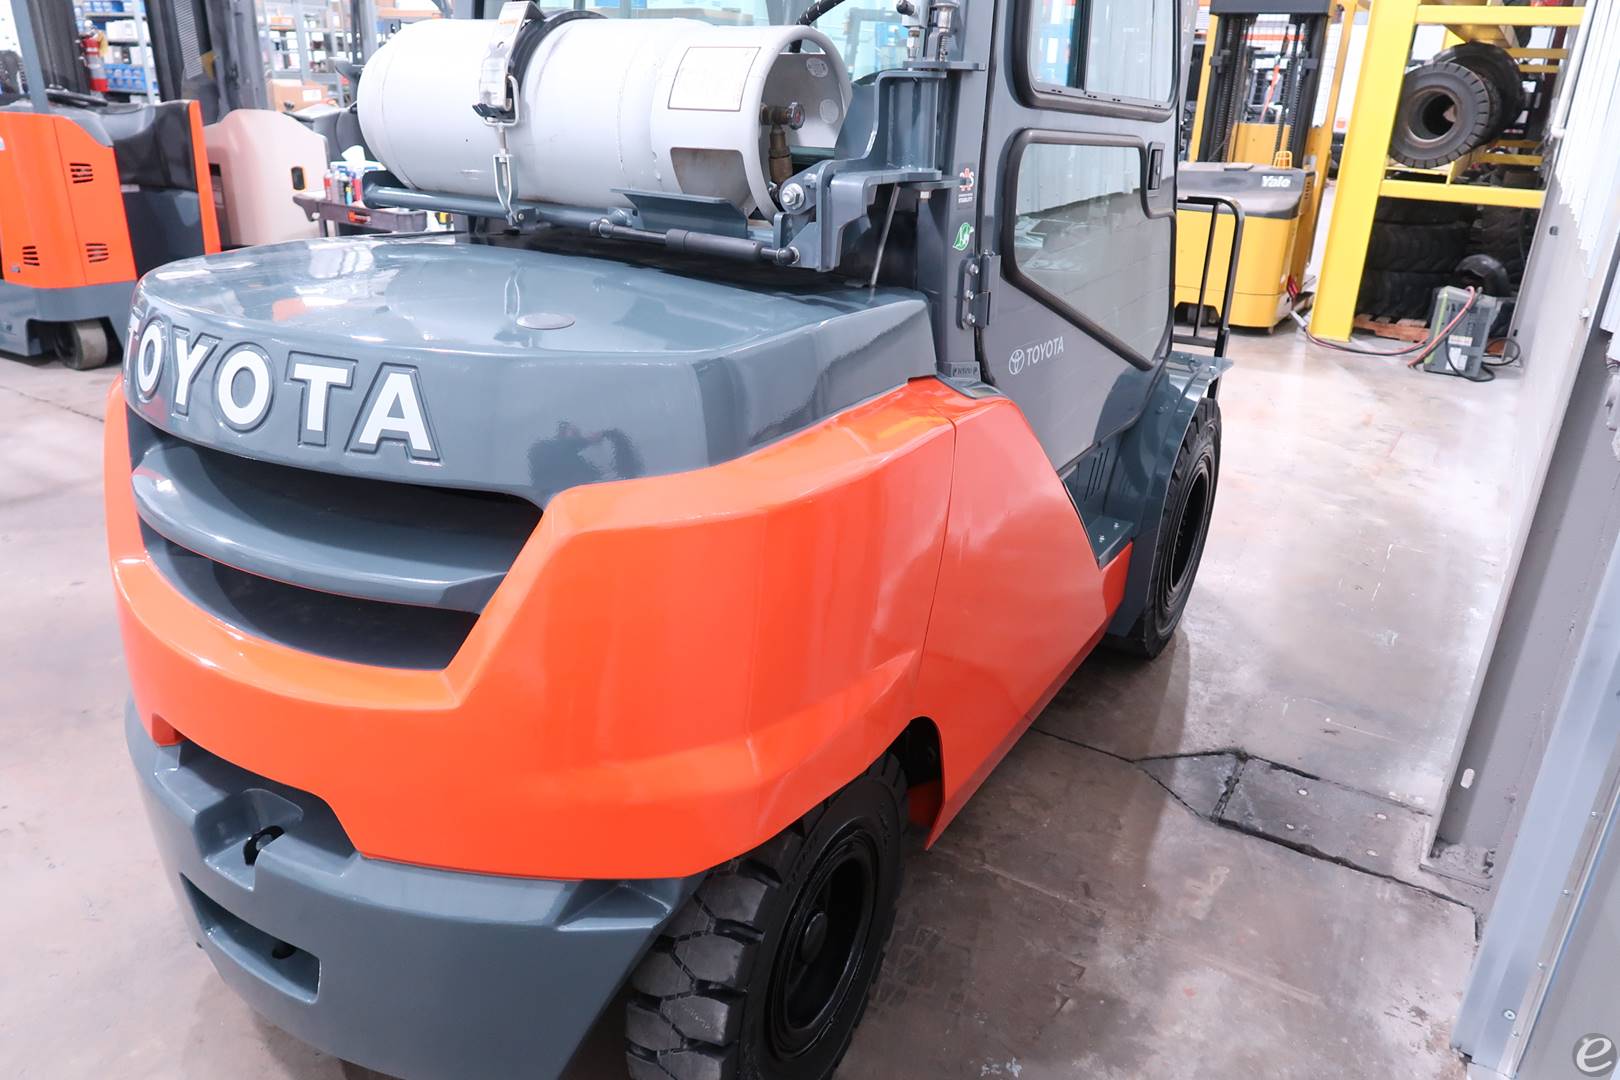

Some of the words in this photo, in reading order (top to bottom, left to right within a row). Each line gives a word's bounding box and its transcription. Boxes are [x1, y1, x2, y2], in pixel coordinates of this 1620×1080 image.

[1261, 175, 1291, 188] Yale
[1026, 335, 1064, 366] TOYOTA
[124, 312, 434, 453] TOYOTA
